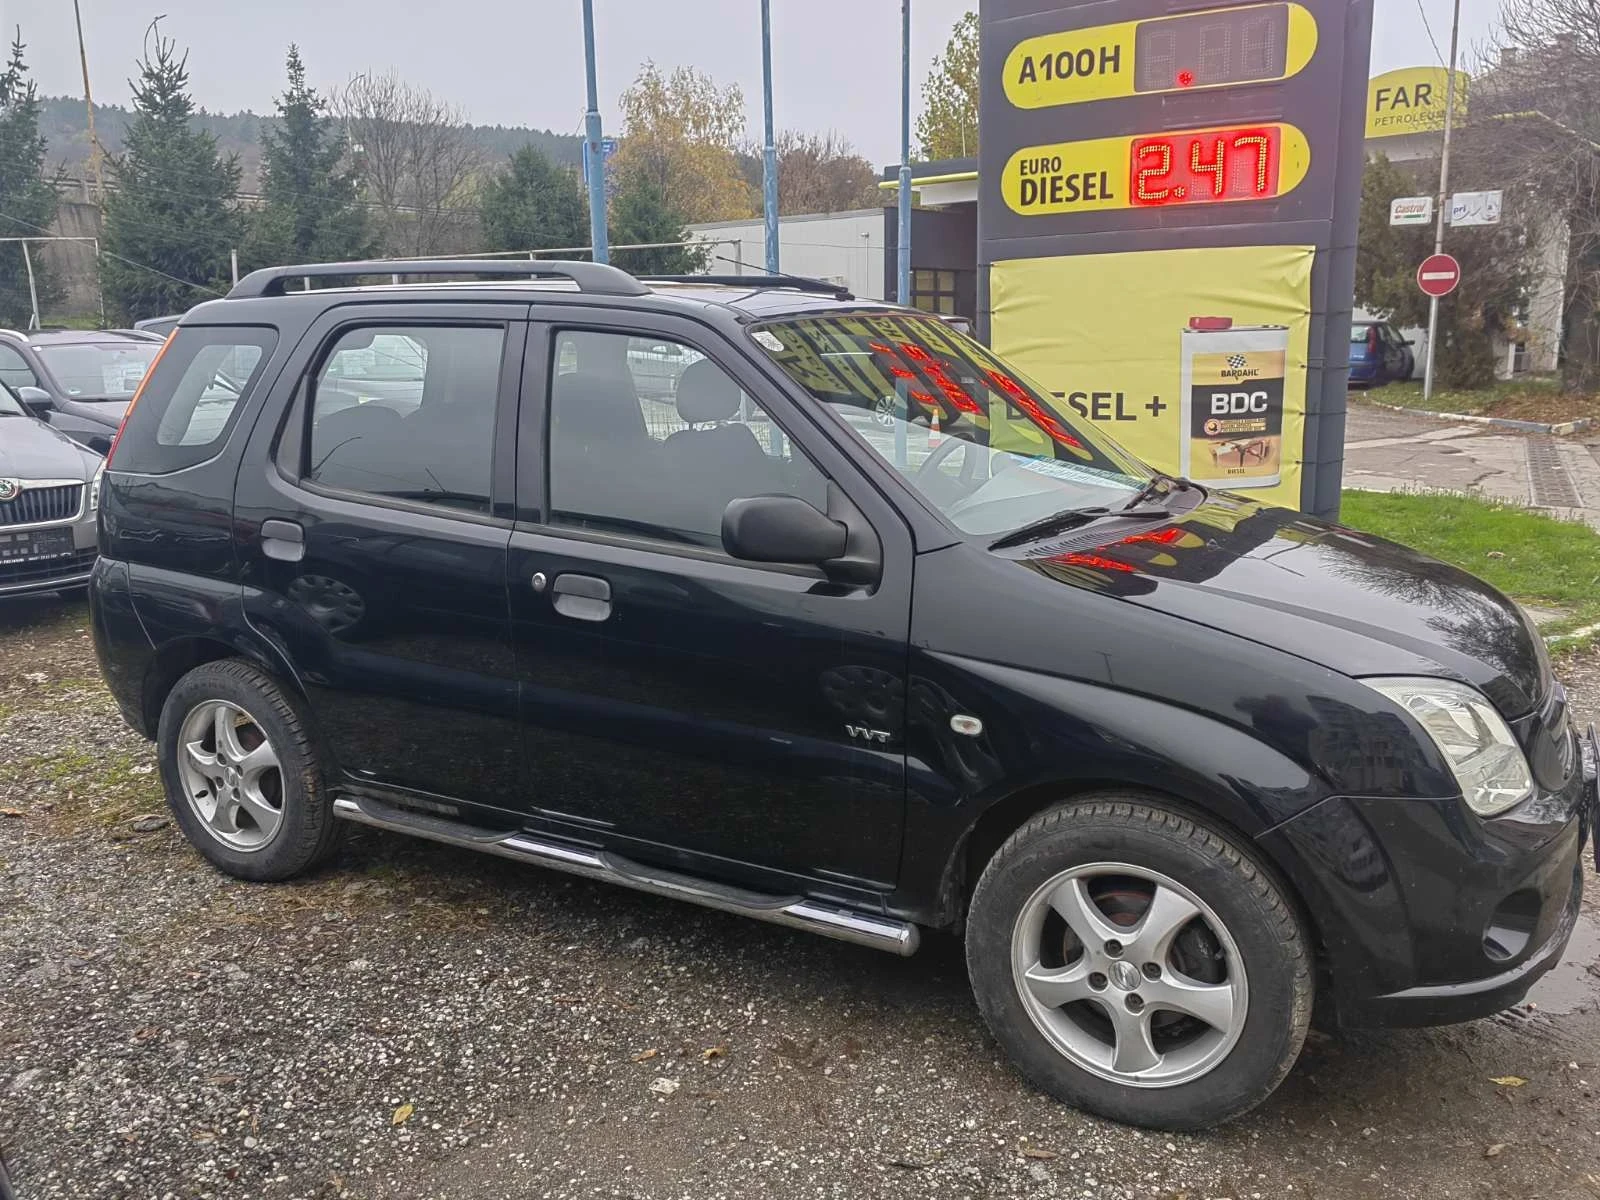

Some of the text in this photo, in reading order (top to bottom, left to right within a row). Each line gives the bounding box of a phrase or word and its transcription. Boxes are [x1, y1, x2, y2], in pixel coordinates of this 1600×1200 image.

[1018, 44, 1121, 85] A100H
[1375, 83, 1432, 112] FAR
[1019, 156, 1062, 176] EURO
[1138, 136, 1268, 200] 2.47
[1019, 171, 1114, 207] DIESEL
[1221, 369, 1259, 378] BARDAHL
[1211, 391, 1268, 414] BDC
[845, 724, 891, 743] VVT
